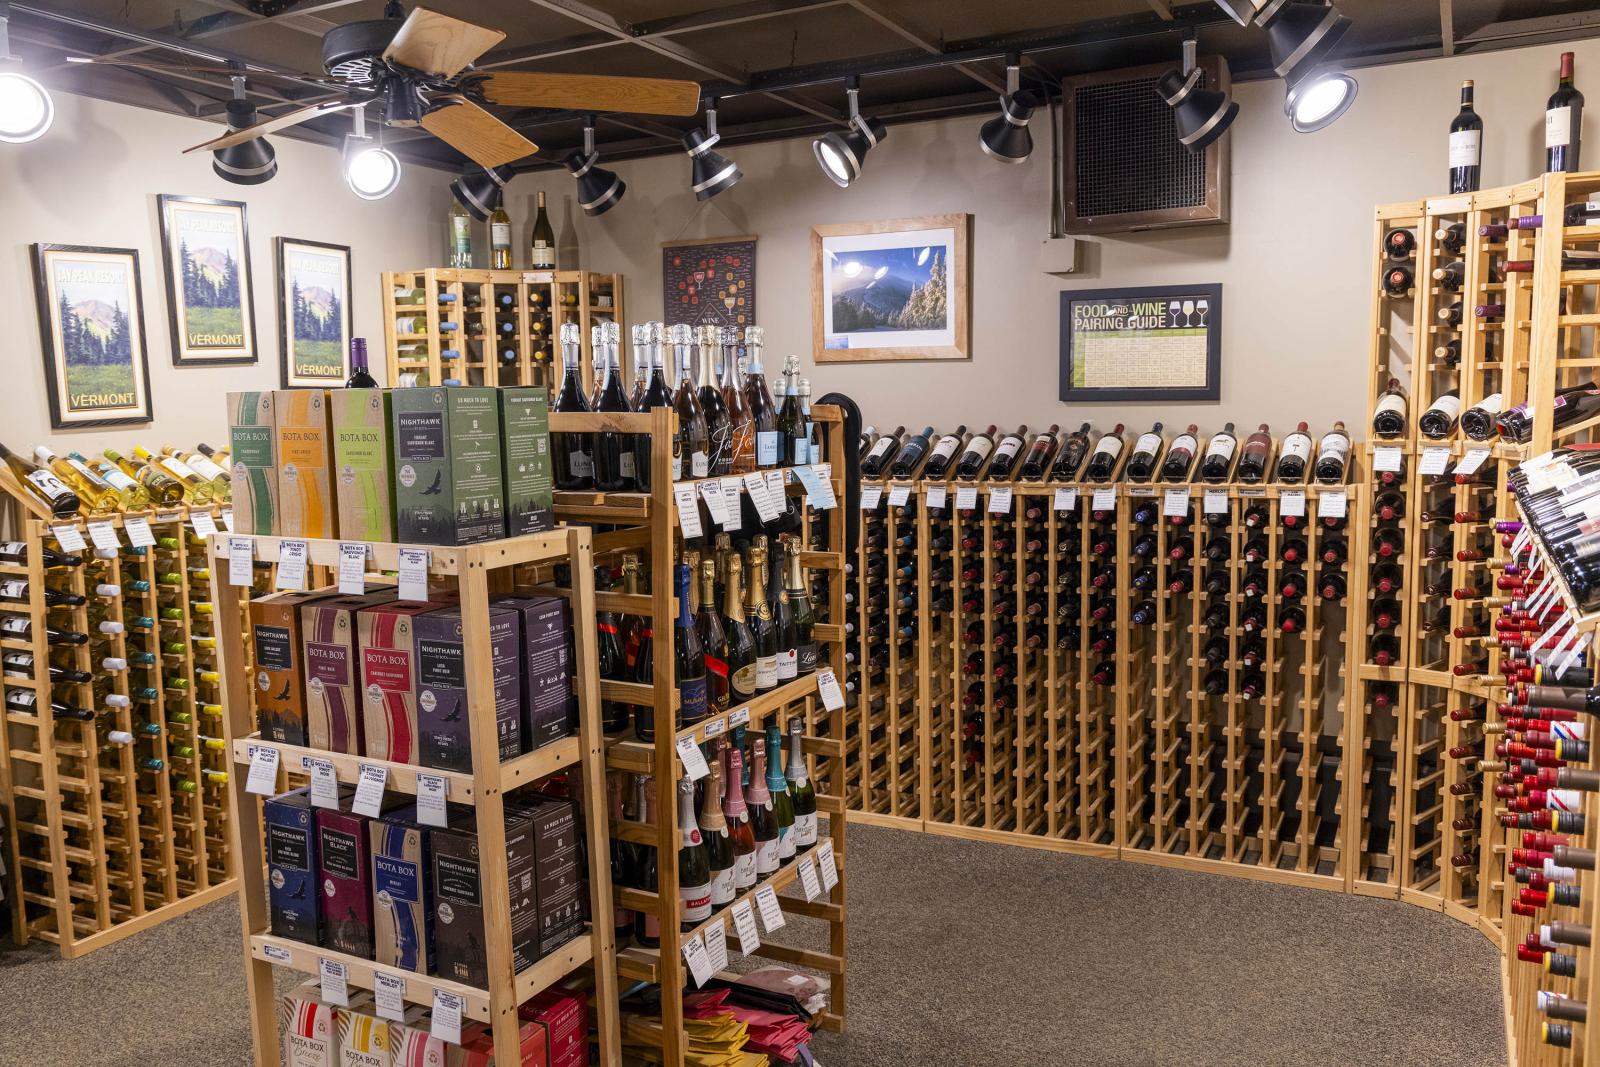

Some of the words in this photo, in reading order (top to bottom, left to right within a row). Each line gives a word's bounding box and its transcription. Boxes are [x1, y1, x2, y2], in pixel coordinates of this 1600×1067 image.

[1075, 305, 1109, 318] FOOD
[1113, 306, 1128, 315] AND
[1132, 302, 1166, 316] WINE
[1075, 318, 1122, 331] PAIRING
[1128, 316, 1166, 329] GUIDE
[189, 334, 242, 346] VERMONT
[296, 364, 342, 376] VERMONT
[71, 393, 135, 407] VERMONT
[401, 417, 441, 425] NIGHTHAWK
[233, 432, 252, 441] BOTA
[253, 432, 269, 441] BOX
[283, 432, 302, 441] BOTA
[304, 432, 320, 441] BOX
[340, 433, 360, 442] BOTA
[362, 433, 378, 442] BOX
[257, 631, 288, 639] NIGHTHAWK
[309, 648, 328, 658] BOTA
[329, 650, 345, 660] BOX
[422, 646, 461, 655] NIGHTHAWK
[367, 653, 388, 663] BOTA
[389, 656, 408, 666] BOX
[272, 829, 305, 841] NIGHTHAWK
[323, 833, 354, 847] NIGHTHAWK
[329, 841, 347, 850] BLACK
[377, 861, 397, 873] BOTA
[398, 865, 415, 877] BOX
[439, 860, 477, 875] NIGHTHAWK
[290, 1036, 308, 1049] BOTA
[309, 1040, 324, 1052] BOX
[346, 1050, 364, 1062] BOTA
[364, 1055, 381, 1066] BOX
